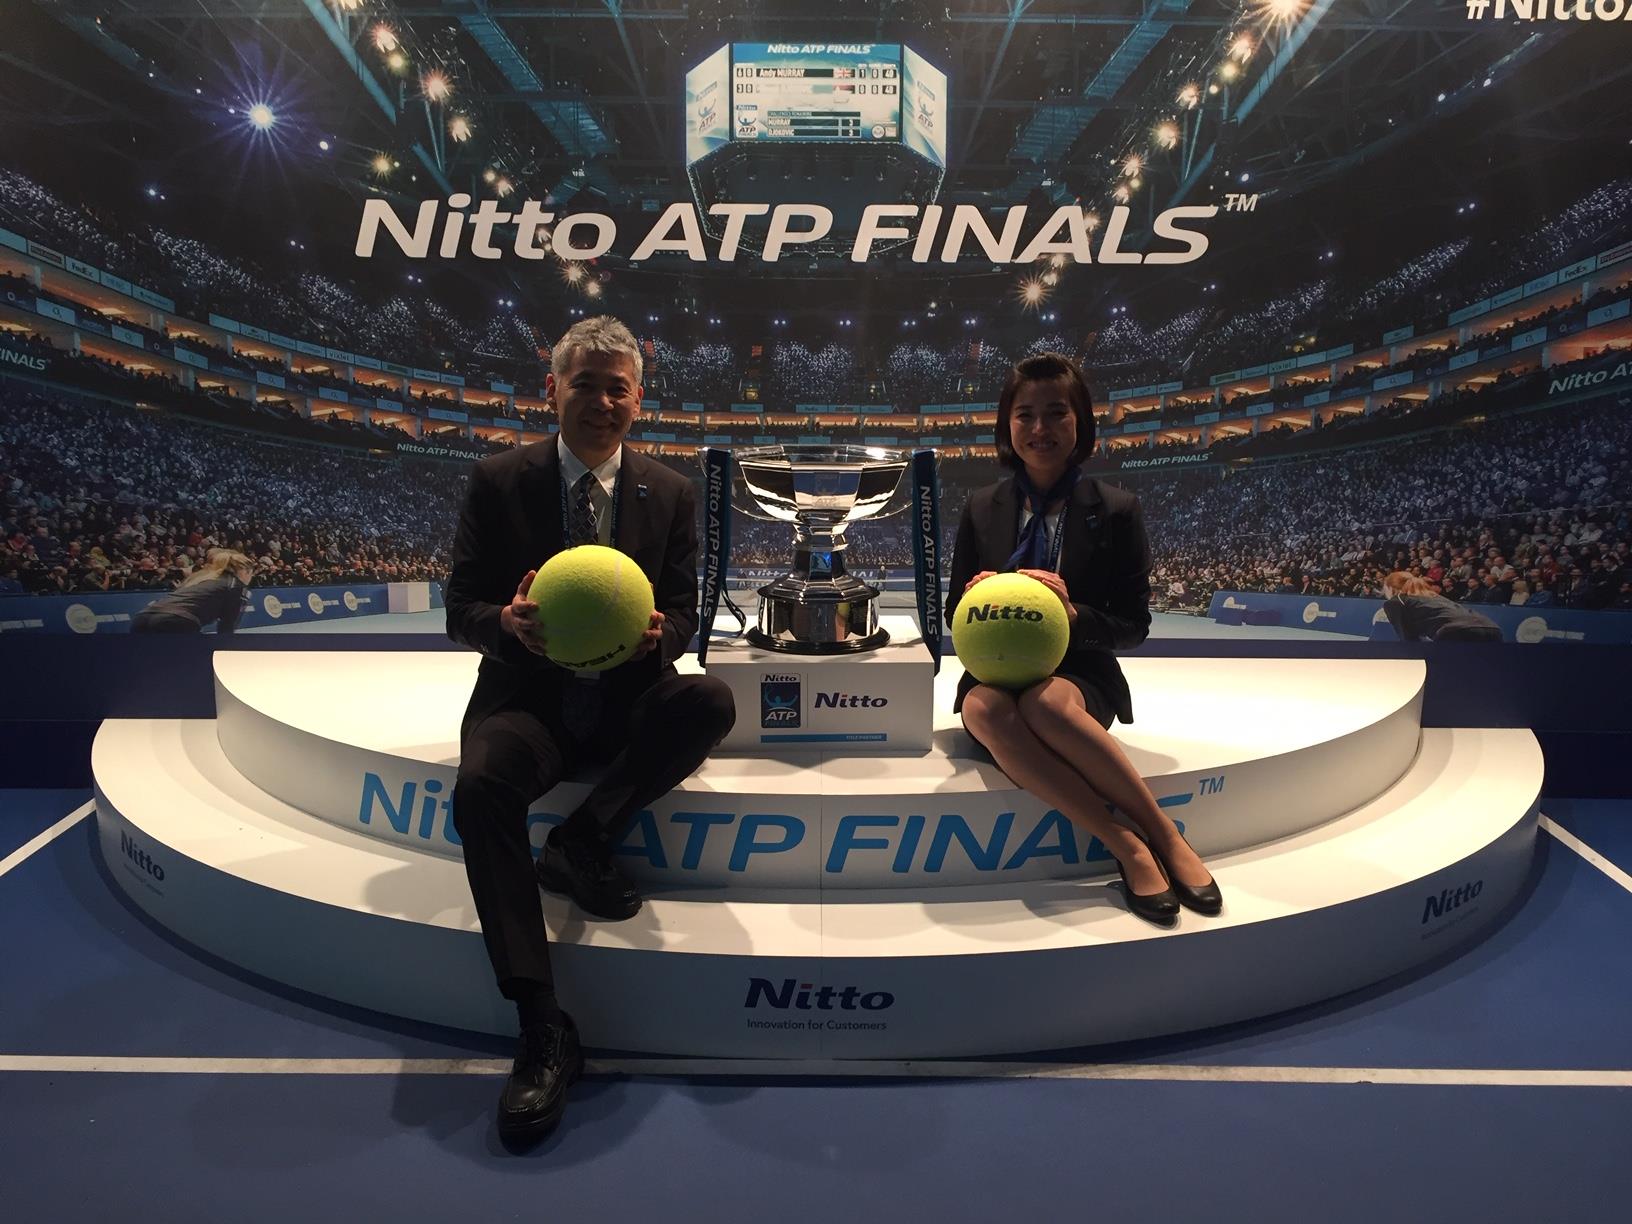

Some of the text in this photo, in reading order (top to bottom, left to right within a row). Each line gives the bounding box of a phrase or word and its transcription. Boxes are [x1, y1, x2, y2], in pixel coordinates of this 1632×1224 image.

[767, 43, 871, 54] Nitto ATP FINALS
[777, 68, 805, 77] MURRAY
[355, 193, 617, 260] Nitto
[630, 202, 833, 262] ATP
[850, 205, 1219, 264] FINALS
[0, 348, 46, 370] INALS
[1548, 370, 1608, 395] Nitto
[397, 443, 488, 460] Nitto ATP FINALS
[1121, 453, 1209, 469] Nitto ATP FINALS
[703, 464, 722, 618] Nitto ATP FINALS
[920, 486, 938, 636] Nitto ATP FINALS
[967, 603, 1044, 624] Nitto
[764, 674, 797, 682] Nitto
[814, 692, 888, 708] Nitto
[764, 711, 797, 721] ATP
[121, 829, 165, 881] Nitto
[1422, 880, 1483, 924] Nitto
[744, 977, 895, 1010] Nitto
[747, 1019, 887, 1030] Innovation for Customers
